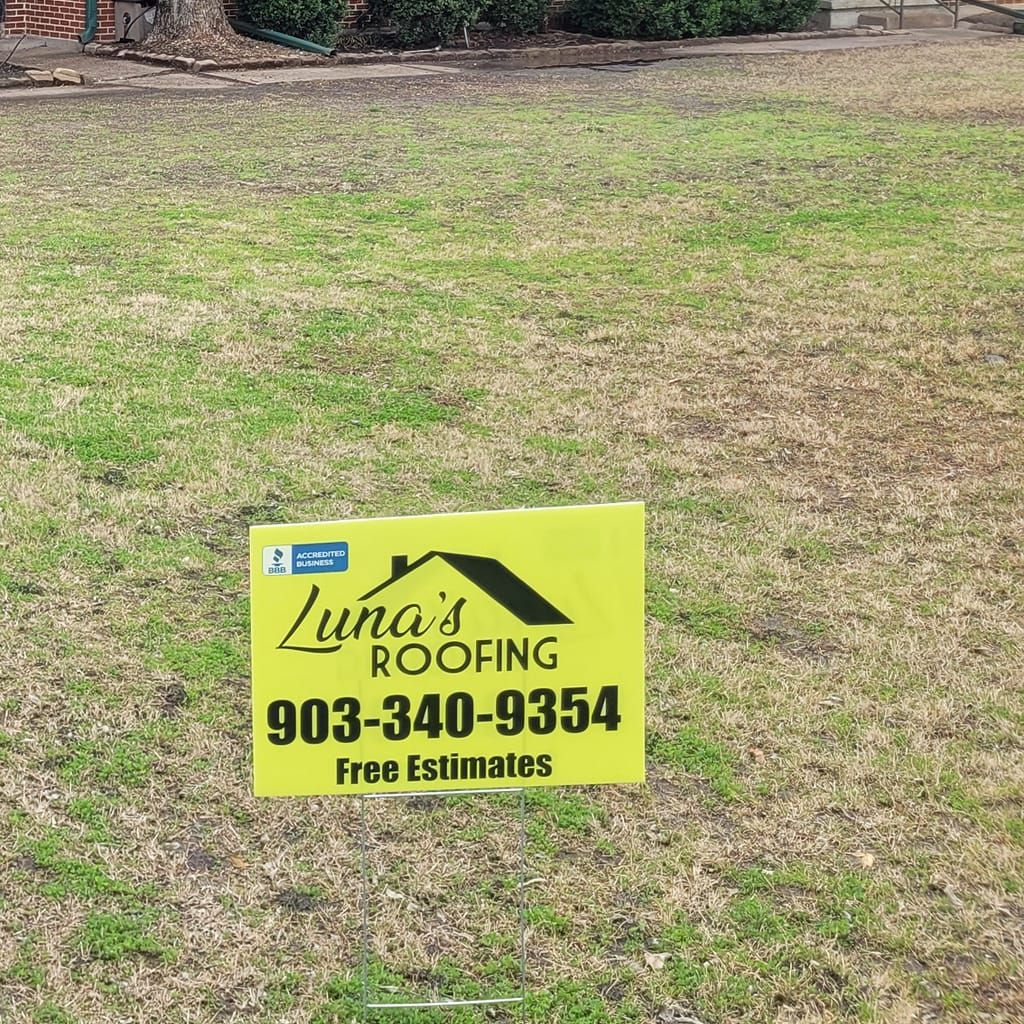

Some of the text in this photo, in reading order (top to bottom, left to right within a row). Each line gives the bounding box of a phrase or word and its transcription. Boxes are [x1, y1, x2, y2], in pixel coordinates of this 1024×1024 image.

[268, 566, 286, 574] BBB
[296, 550, 345, 559] ACCREDITED
[296, 559, 334, 568] BUSINESS
[276, 584, 467, 654] Luna's
[371, 636, 558, 678] ROOFING
[267, 685, 621, 745] 903-340-9354
[336, 752, 553, 785] Free Estimates
